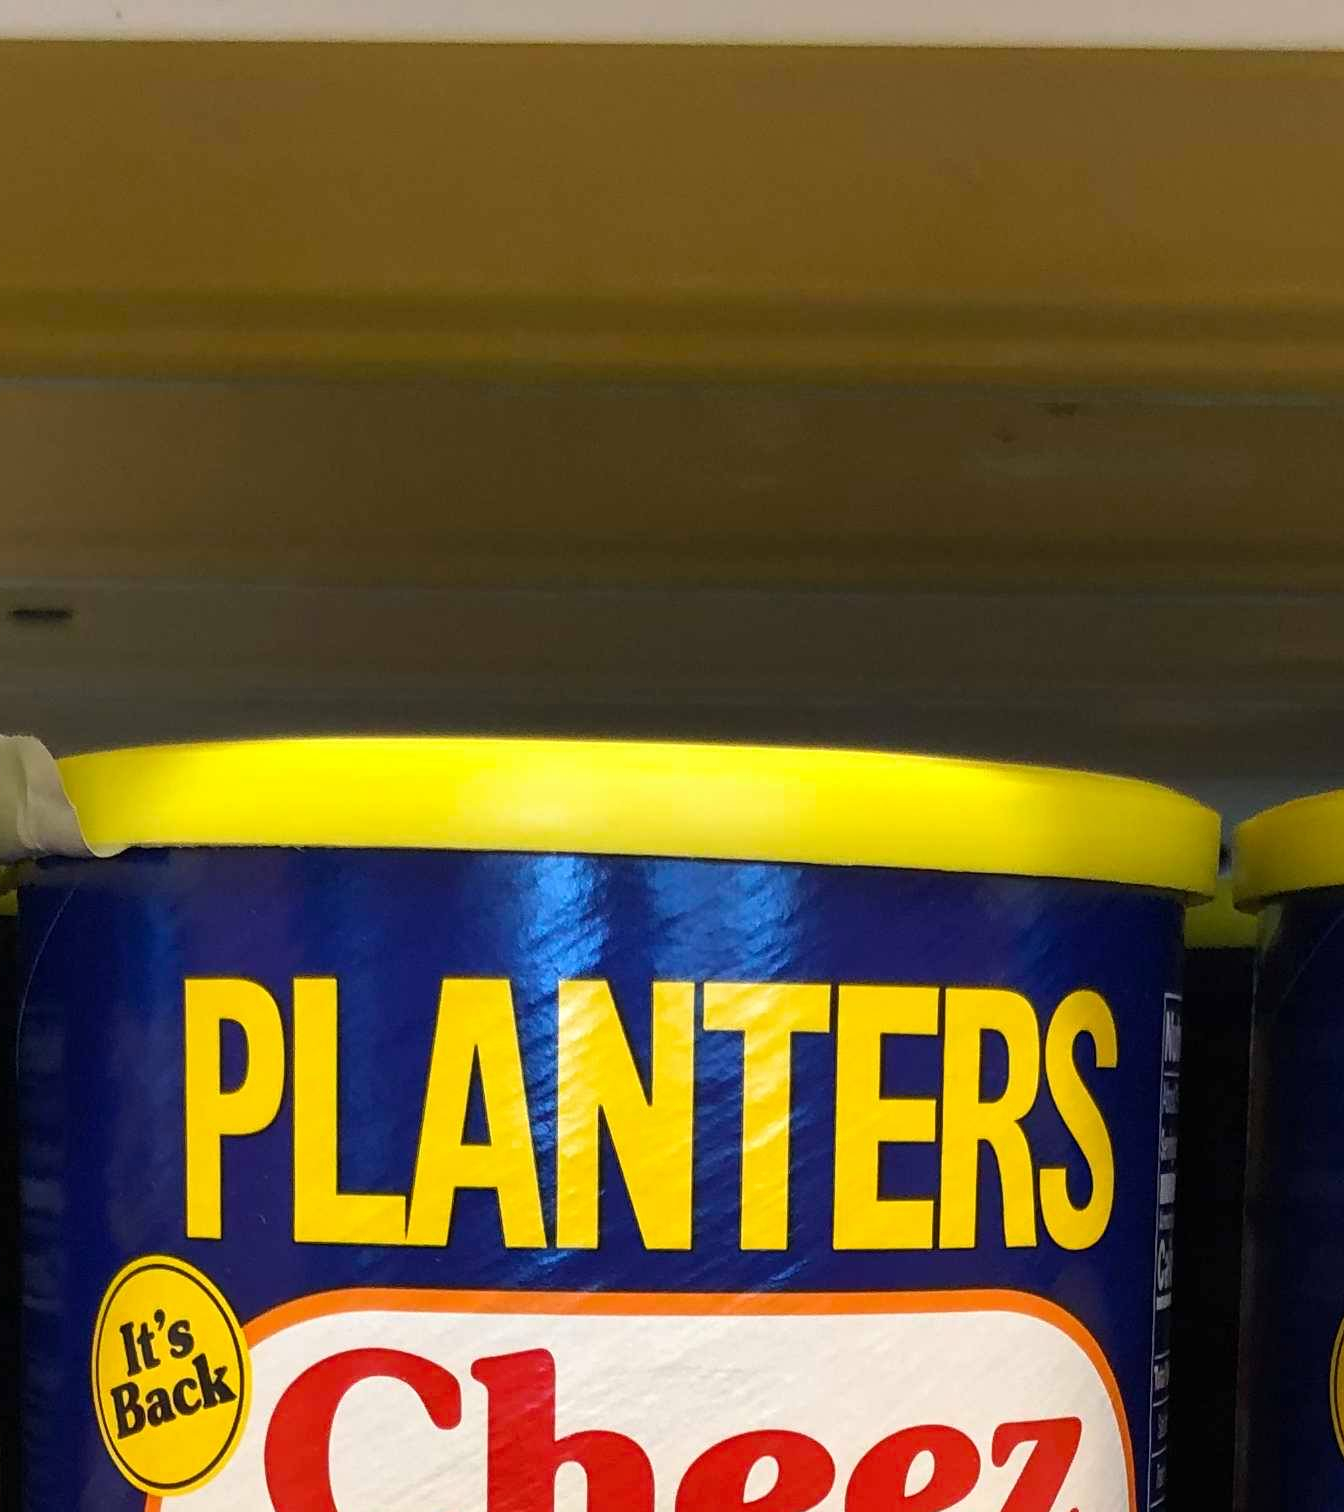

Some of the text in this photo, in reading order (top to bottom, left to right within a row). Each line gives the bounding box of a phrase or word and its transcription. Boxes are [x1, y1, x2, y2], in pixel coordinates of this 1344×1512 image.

[184, 978, 1118, 1250] PLANTERS
[120, 1310, 194, 1376] It's
[111, 1357, 236, 1440] Back
